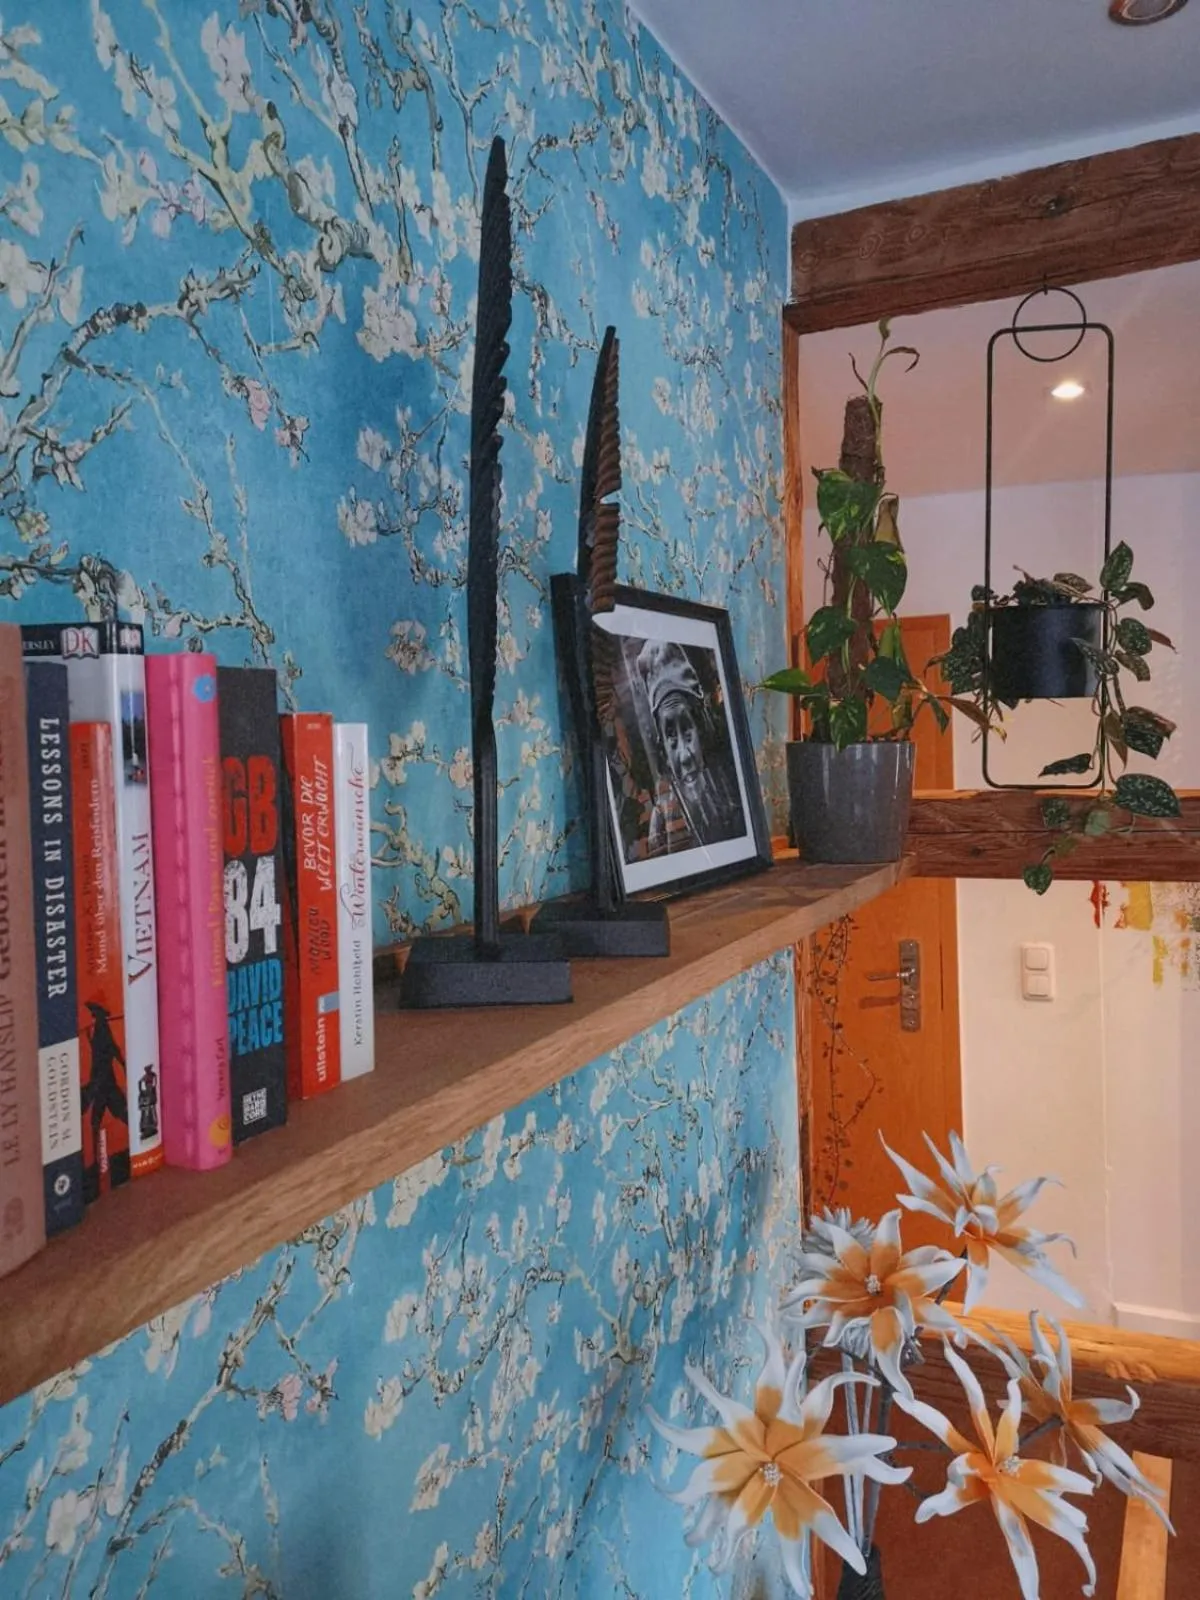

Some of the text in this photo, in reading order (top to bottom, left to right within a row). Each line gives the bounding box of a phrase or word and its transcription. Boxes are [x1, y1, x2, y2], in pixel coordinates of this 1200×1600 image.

[63, 628, 97, 654] DK
[221, 755, 278, 858] GB
[40, 717, 68, 999] LESSONS IN DISASTER
[91, 861, 104, 889] den
[223, 855, 281, 964] 84
[94, 930, 108, 974] Mond
[227, 959, 282, 1013] DAVID
[228, 1000, 283, 1056] PEACE
[315, 1017, 327, 1082] ullstein
[47, 1056, 58, 1150] GOLDSTEIN
[60, 1052, 71, 1123] GORDON
